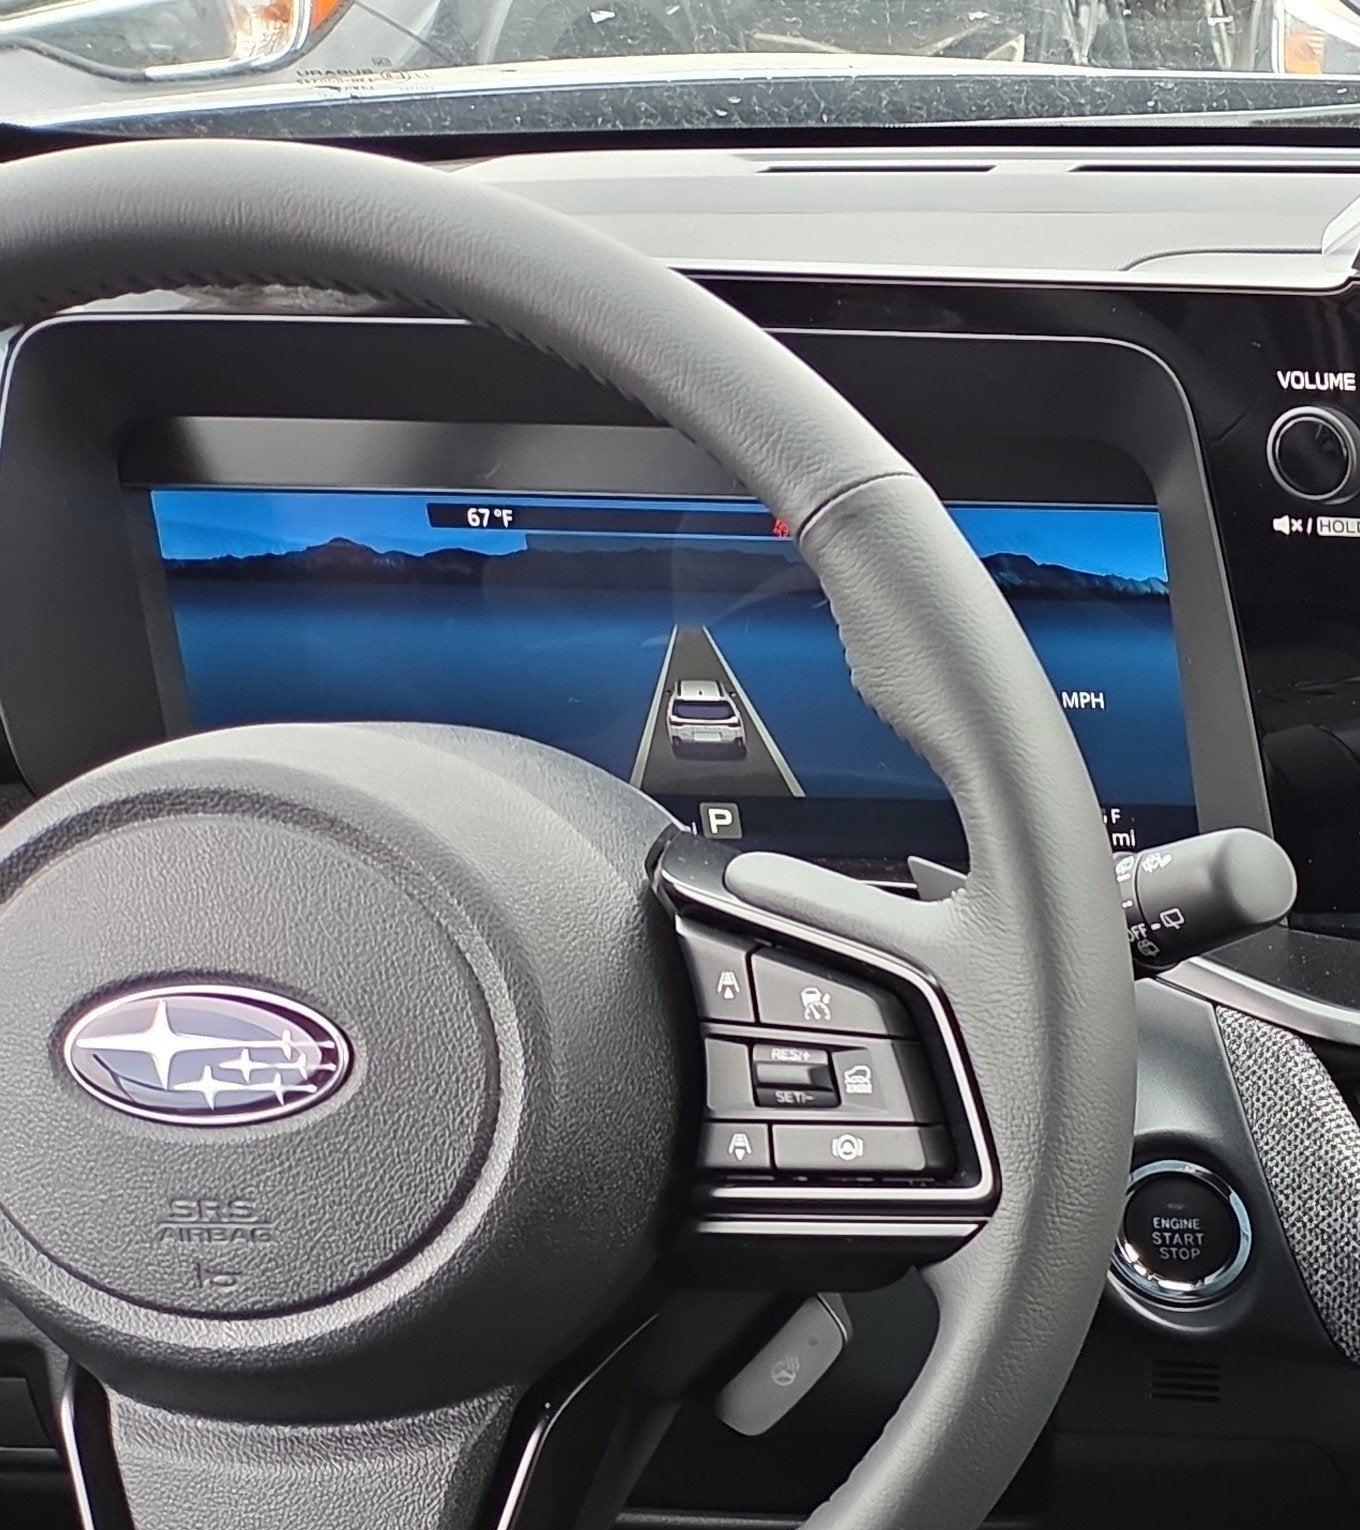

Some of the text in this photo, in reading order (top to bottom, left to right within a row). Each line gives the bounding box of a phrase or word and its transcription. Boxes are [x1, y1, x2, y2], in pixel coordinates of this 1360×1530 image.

[1277, 370, 1356, 392] VOLUME
[1062, 691, 1105, 709] MPH
[708, 808, 733, 834] P
[1112, 829, 1136, 847] mi
[169, 1199, 259, 1223] SRS
[1152, 1216, 1201, 1230] ENGINE
[1151, 1232, 1204, 1245] START
[1159, 1247, 1201, 1260] STOP
